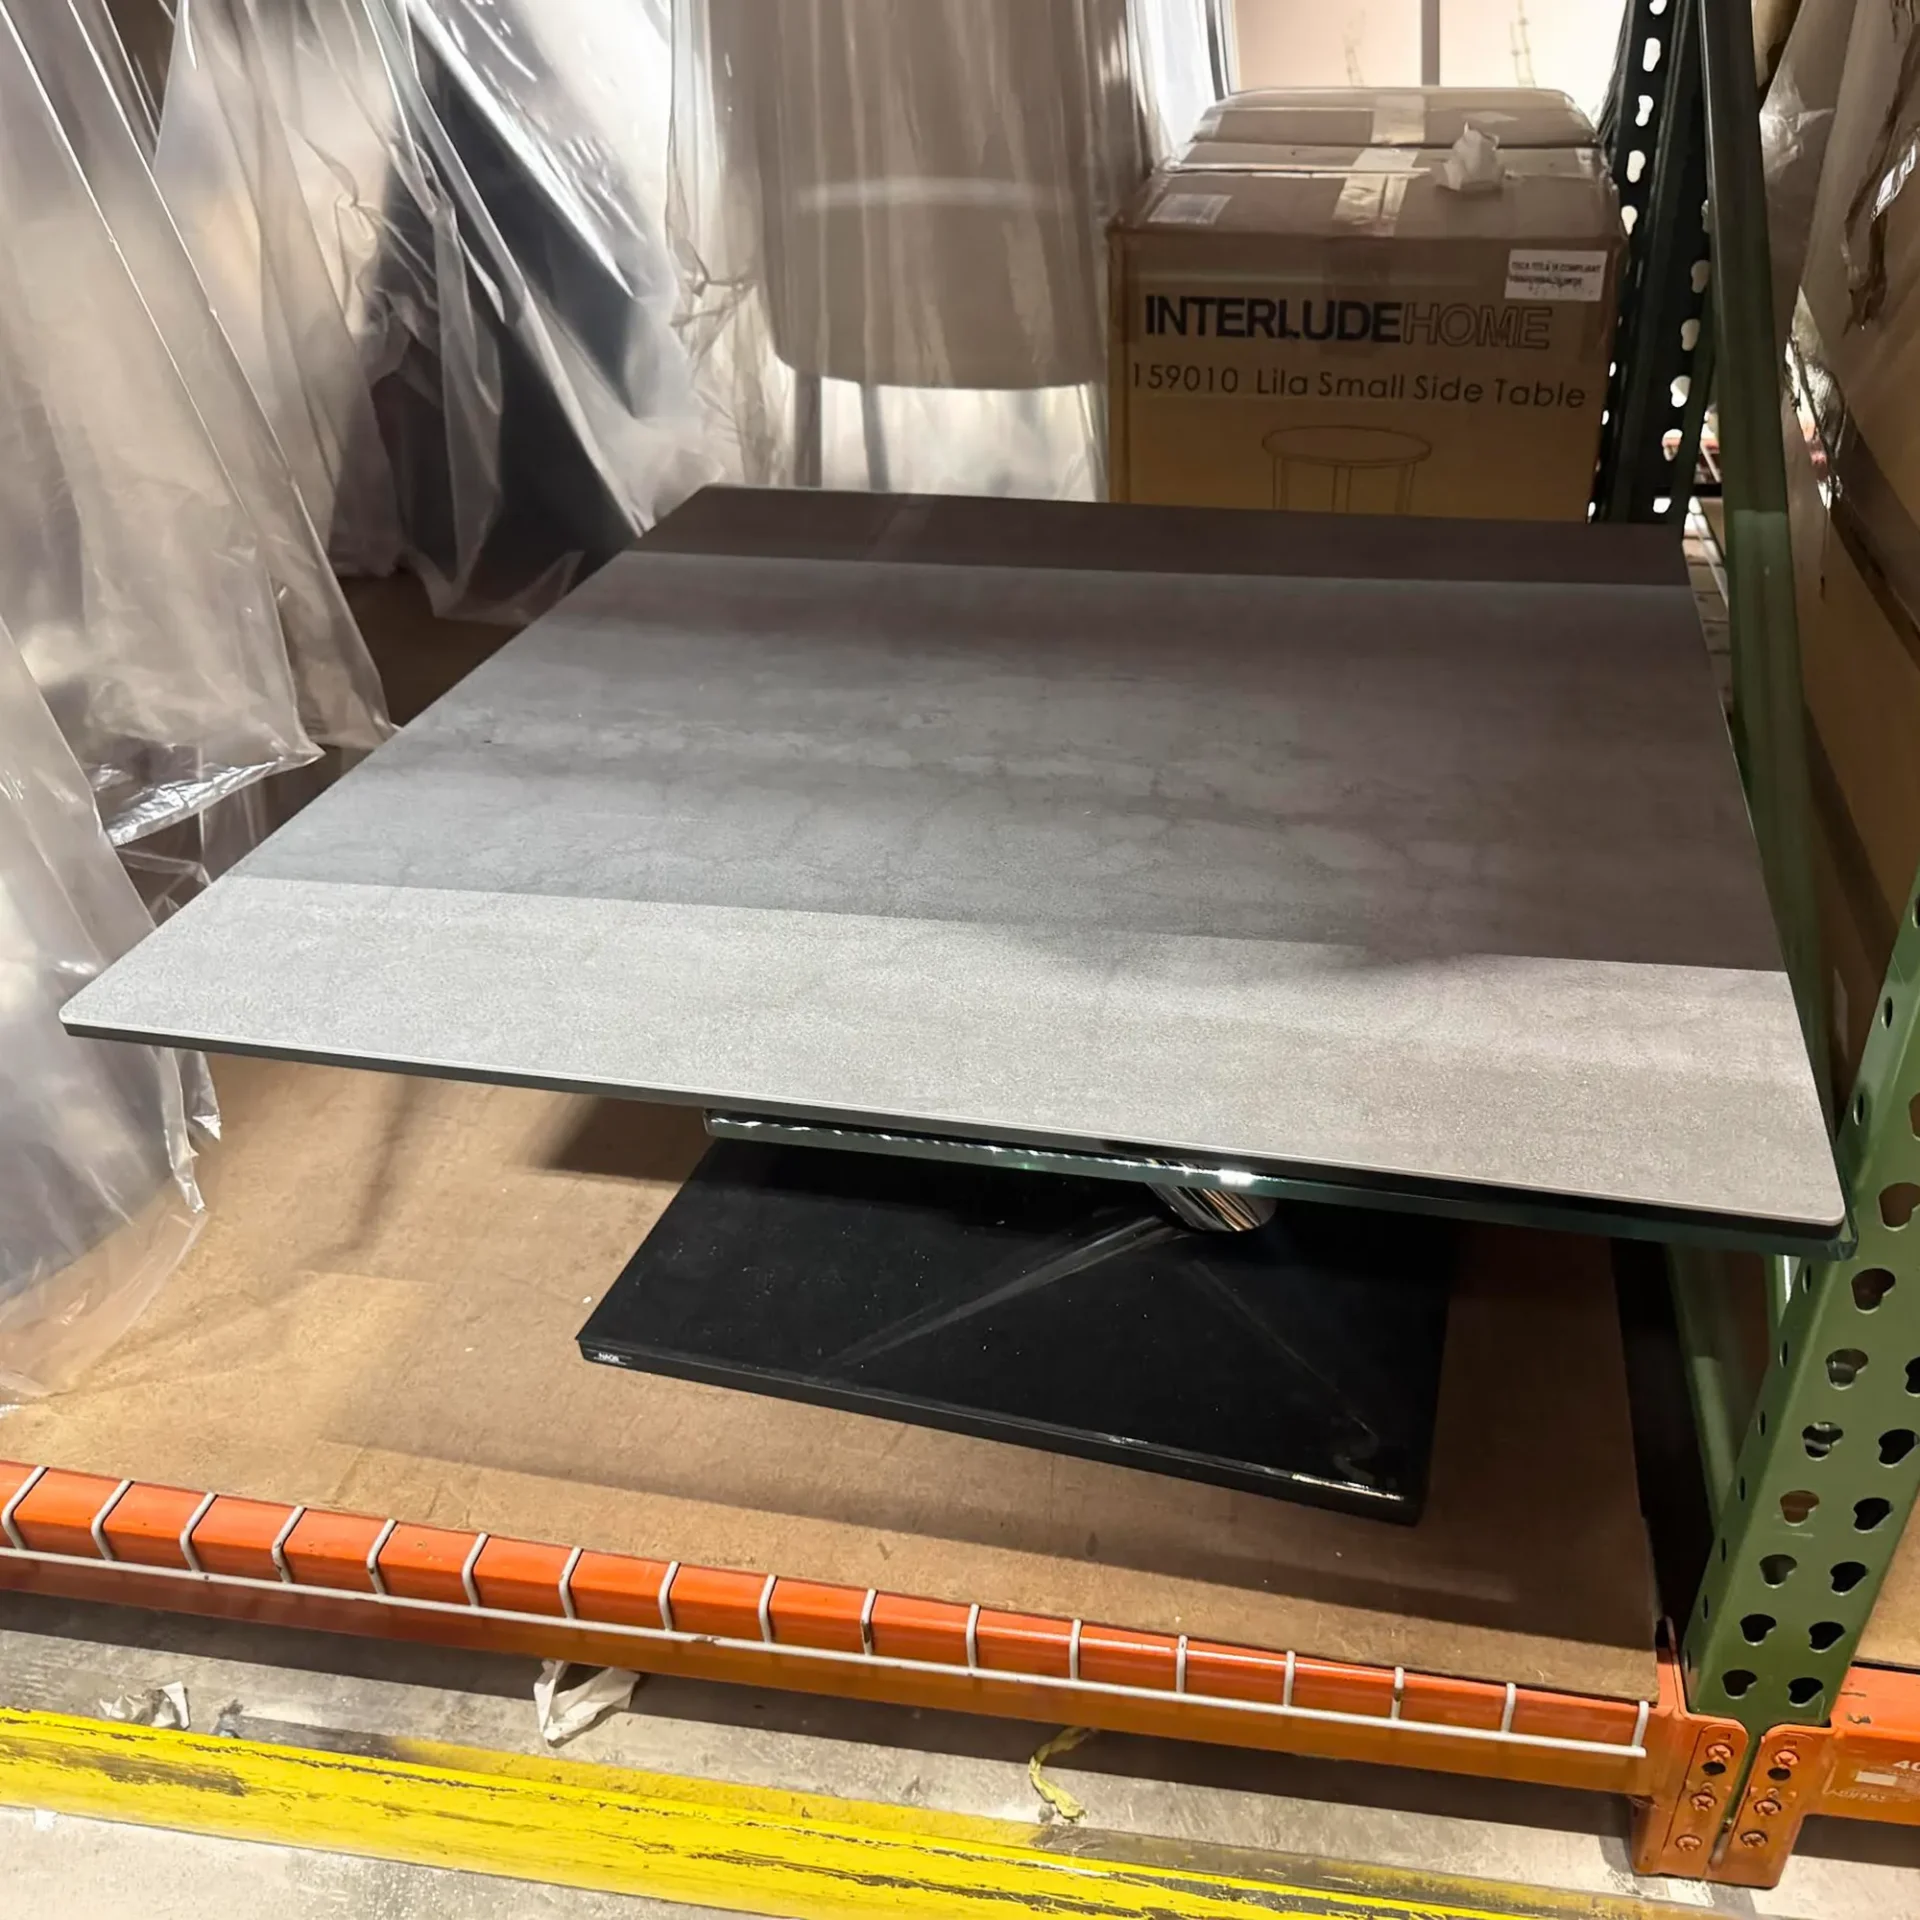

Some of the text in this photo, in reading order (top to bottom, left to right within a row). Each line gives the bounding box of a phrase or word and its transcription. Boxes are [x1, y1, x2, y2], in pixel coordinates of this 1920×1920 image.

[1134, 362, 1586, 408] 159010 Lila Small Side Table
